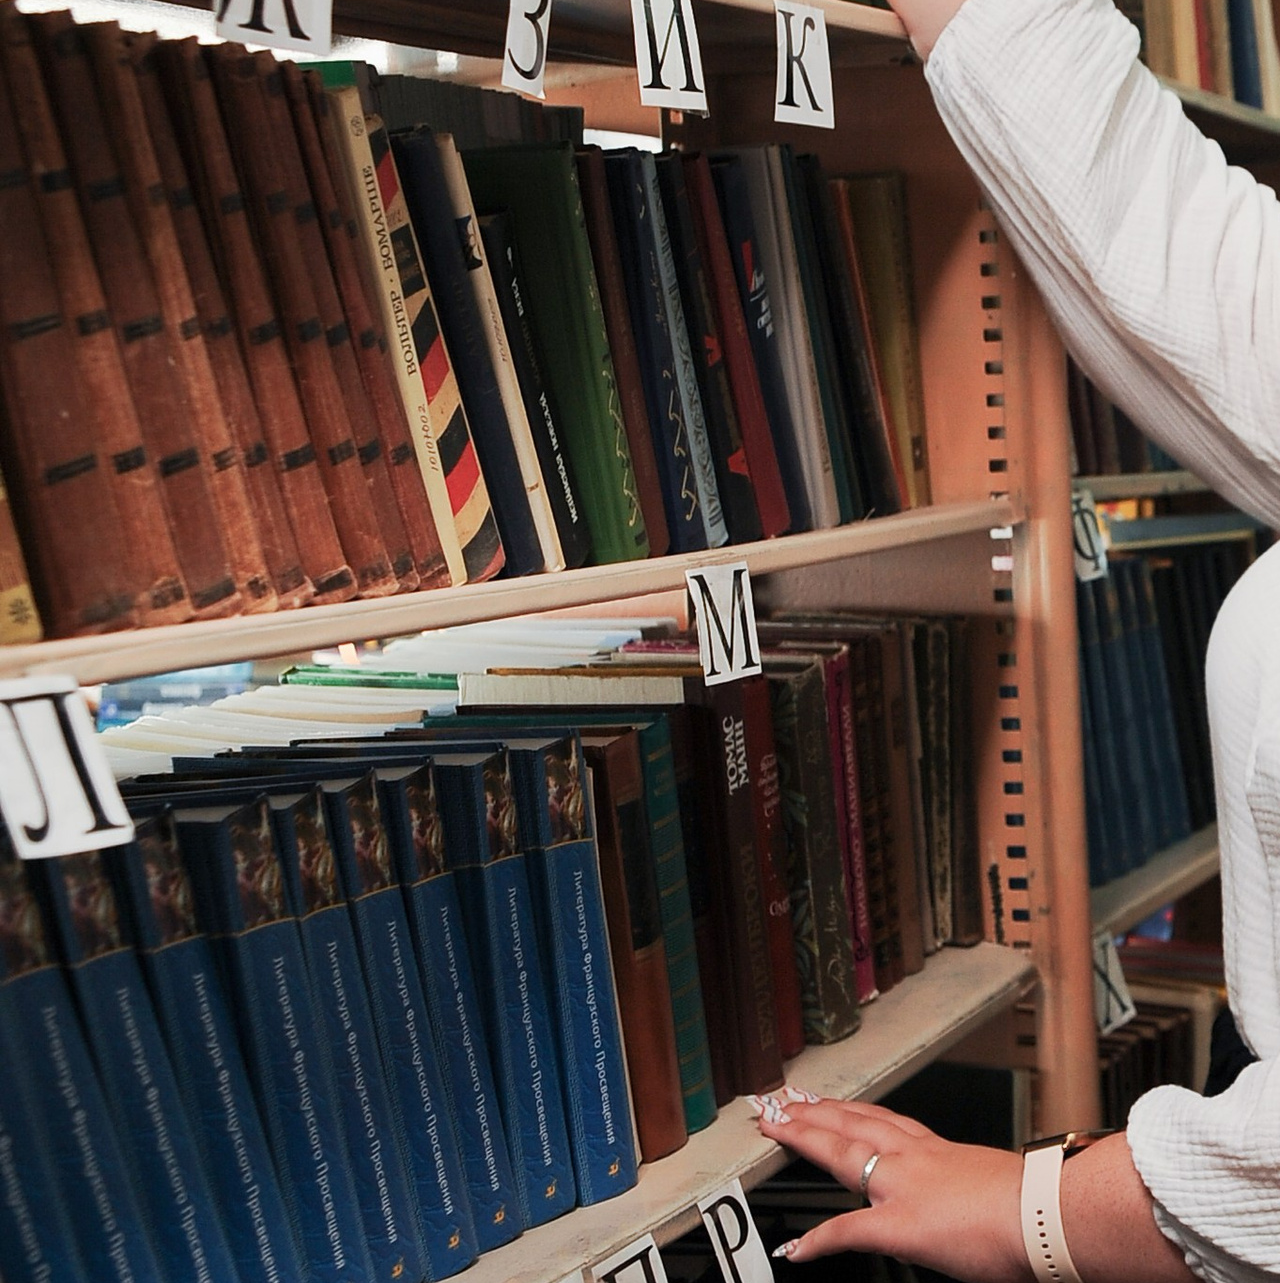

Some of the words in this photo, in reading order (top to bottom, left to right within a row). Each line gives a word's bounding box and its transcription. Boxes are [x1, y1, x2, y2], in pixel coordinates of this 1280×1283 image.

[777, 8, 824, 112] К
[360, 163, 394, 270] БОМАРШЕ
[389, 288, 418, 375] ВОЛЬТЕР
[693, 568, 760, 680] М
[0, 691, 128, 842] Л
[717, 714, 745, 795] ТОМАС
[729, 719, 752, 787] МАНН
[505, 886, 527, 968] Литература
[570, 869, 592, 950] Литература
[437, 905, 463, 990] Литература
[452, 991, 483, 1092] Французского
[471, 1093, 501, 1193] Просвещения
[515, 970, 540, 1068] Французского
[580, 952, 603, 1048] Французского
[270, 956, 301, 1049] Литература
[289, 1050, 325, 1161] Французского
[312, 1161, 349, 1270] Просвещения
[323, 940, 354, 1030] Литература
[343, 1031, 377, 1138] Французского
[365, 1140, 399, 1244] Просвещения
[384, 920, 411, 1007] Литература
[401, 1007, 433, 1113] Французского
[423, 1113, 454, 1217] Просвещения
[593, 1050, 616, 1145] Просвещения
[529, 1070, 554, 1166] Просвещения
